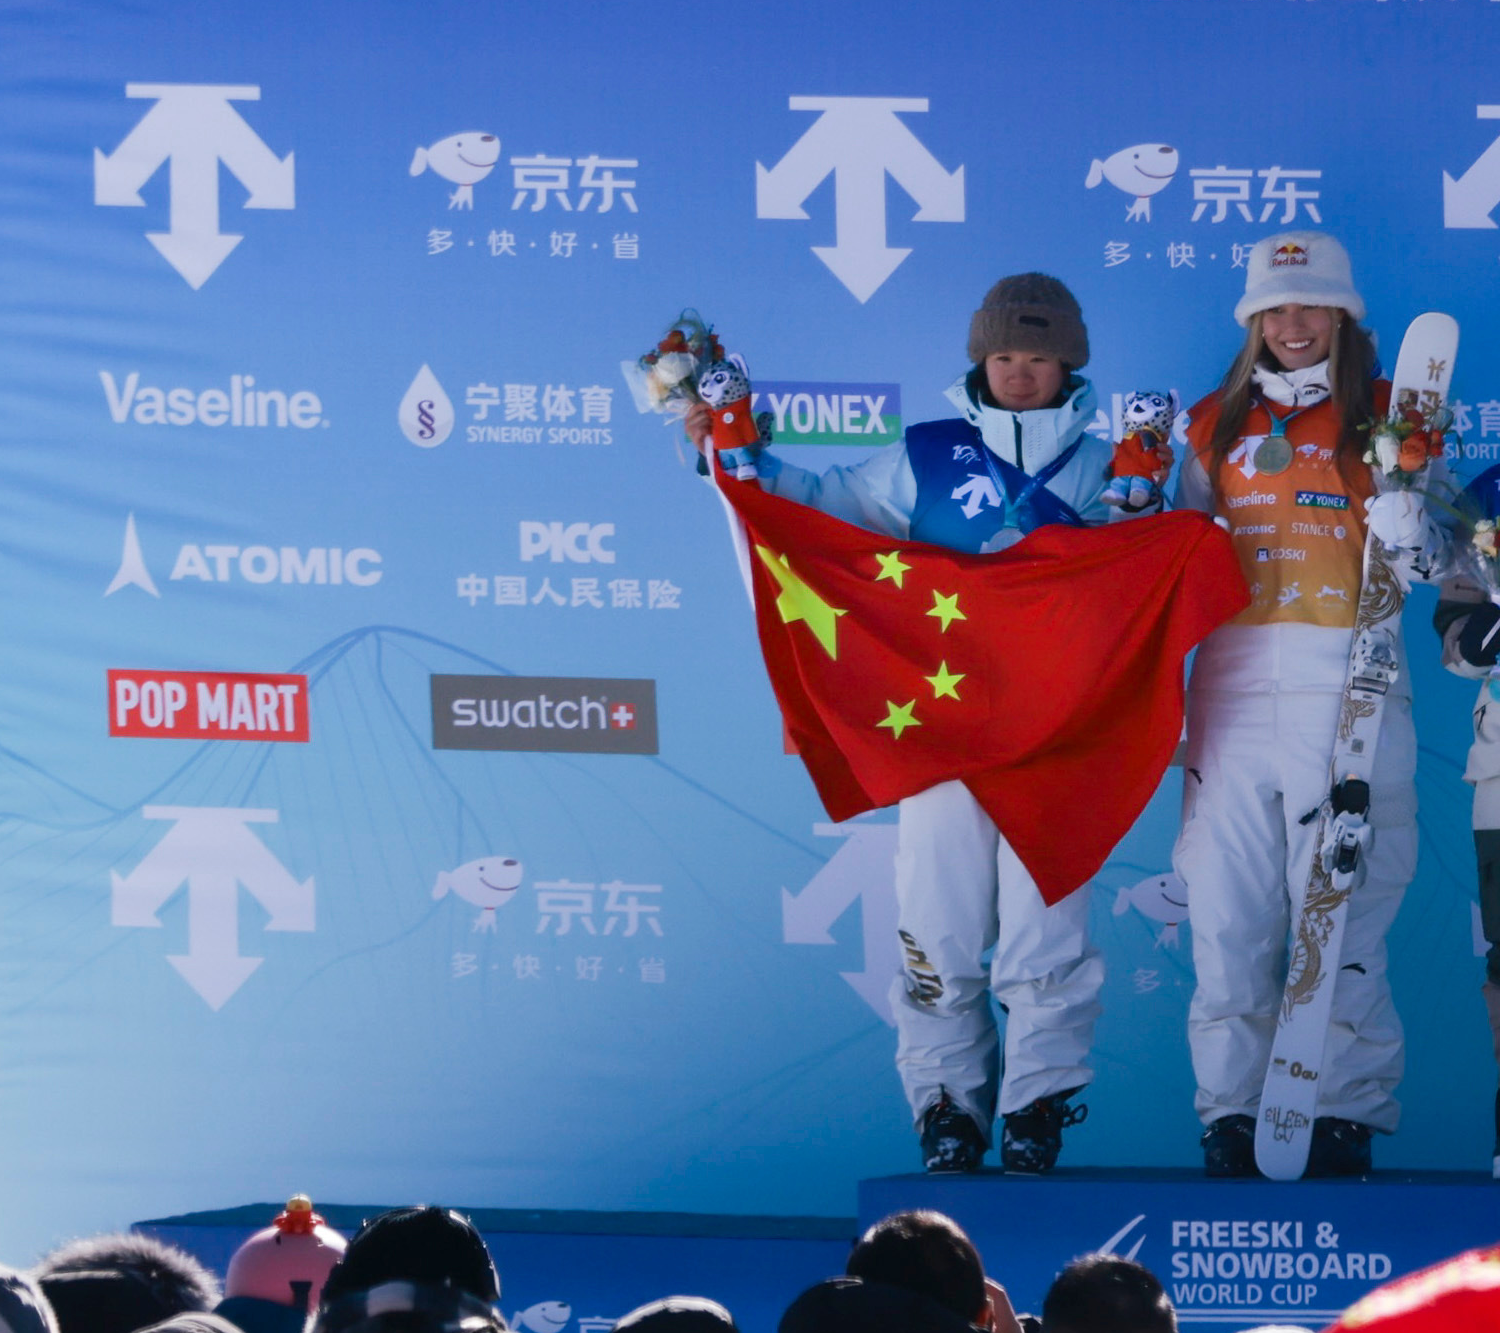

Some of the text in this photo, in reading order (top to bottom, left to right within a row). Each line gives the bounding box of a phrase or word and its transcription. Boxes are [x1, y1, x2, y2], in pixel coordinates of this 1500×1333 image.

[509, 153, 639, 213] 京东
[1189, 164, 1322, 225] 京东
[1272, 256, 1308, 267] Red Bull
[99, 370, 322, 429] Vaseline
[466, 382, 613, 424] 宁聚体育
[768, 394, 887, 436] YONEX
[467, 426, 614, 446] SYNERGY SPORTS
[1316, 495, 1346, 509] YONEX
[519, 520, 616, 564] PICC
[1234, 524, 1276, 536] ATOMIC
[1292, 522, 1330, 537] STANCE
[170, 544, 383, 587] ATOMIC
[456, 573, 682, 609] 中国人民保险
[115, 678, 299, 733] POP MART
[451, 695, 606, 730] swatch
[531, 878, 663, 937] 京东
[1172, 1220, 1339, 1249] FREESKI &
[1171, 1251, 1392, 1280] SNOWBOARD
[1173, 1283, 1317, 1305] WORLD CUP
